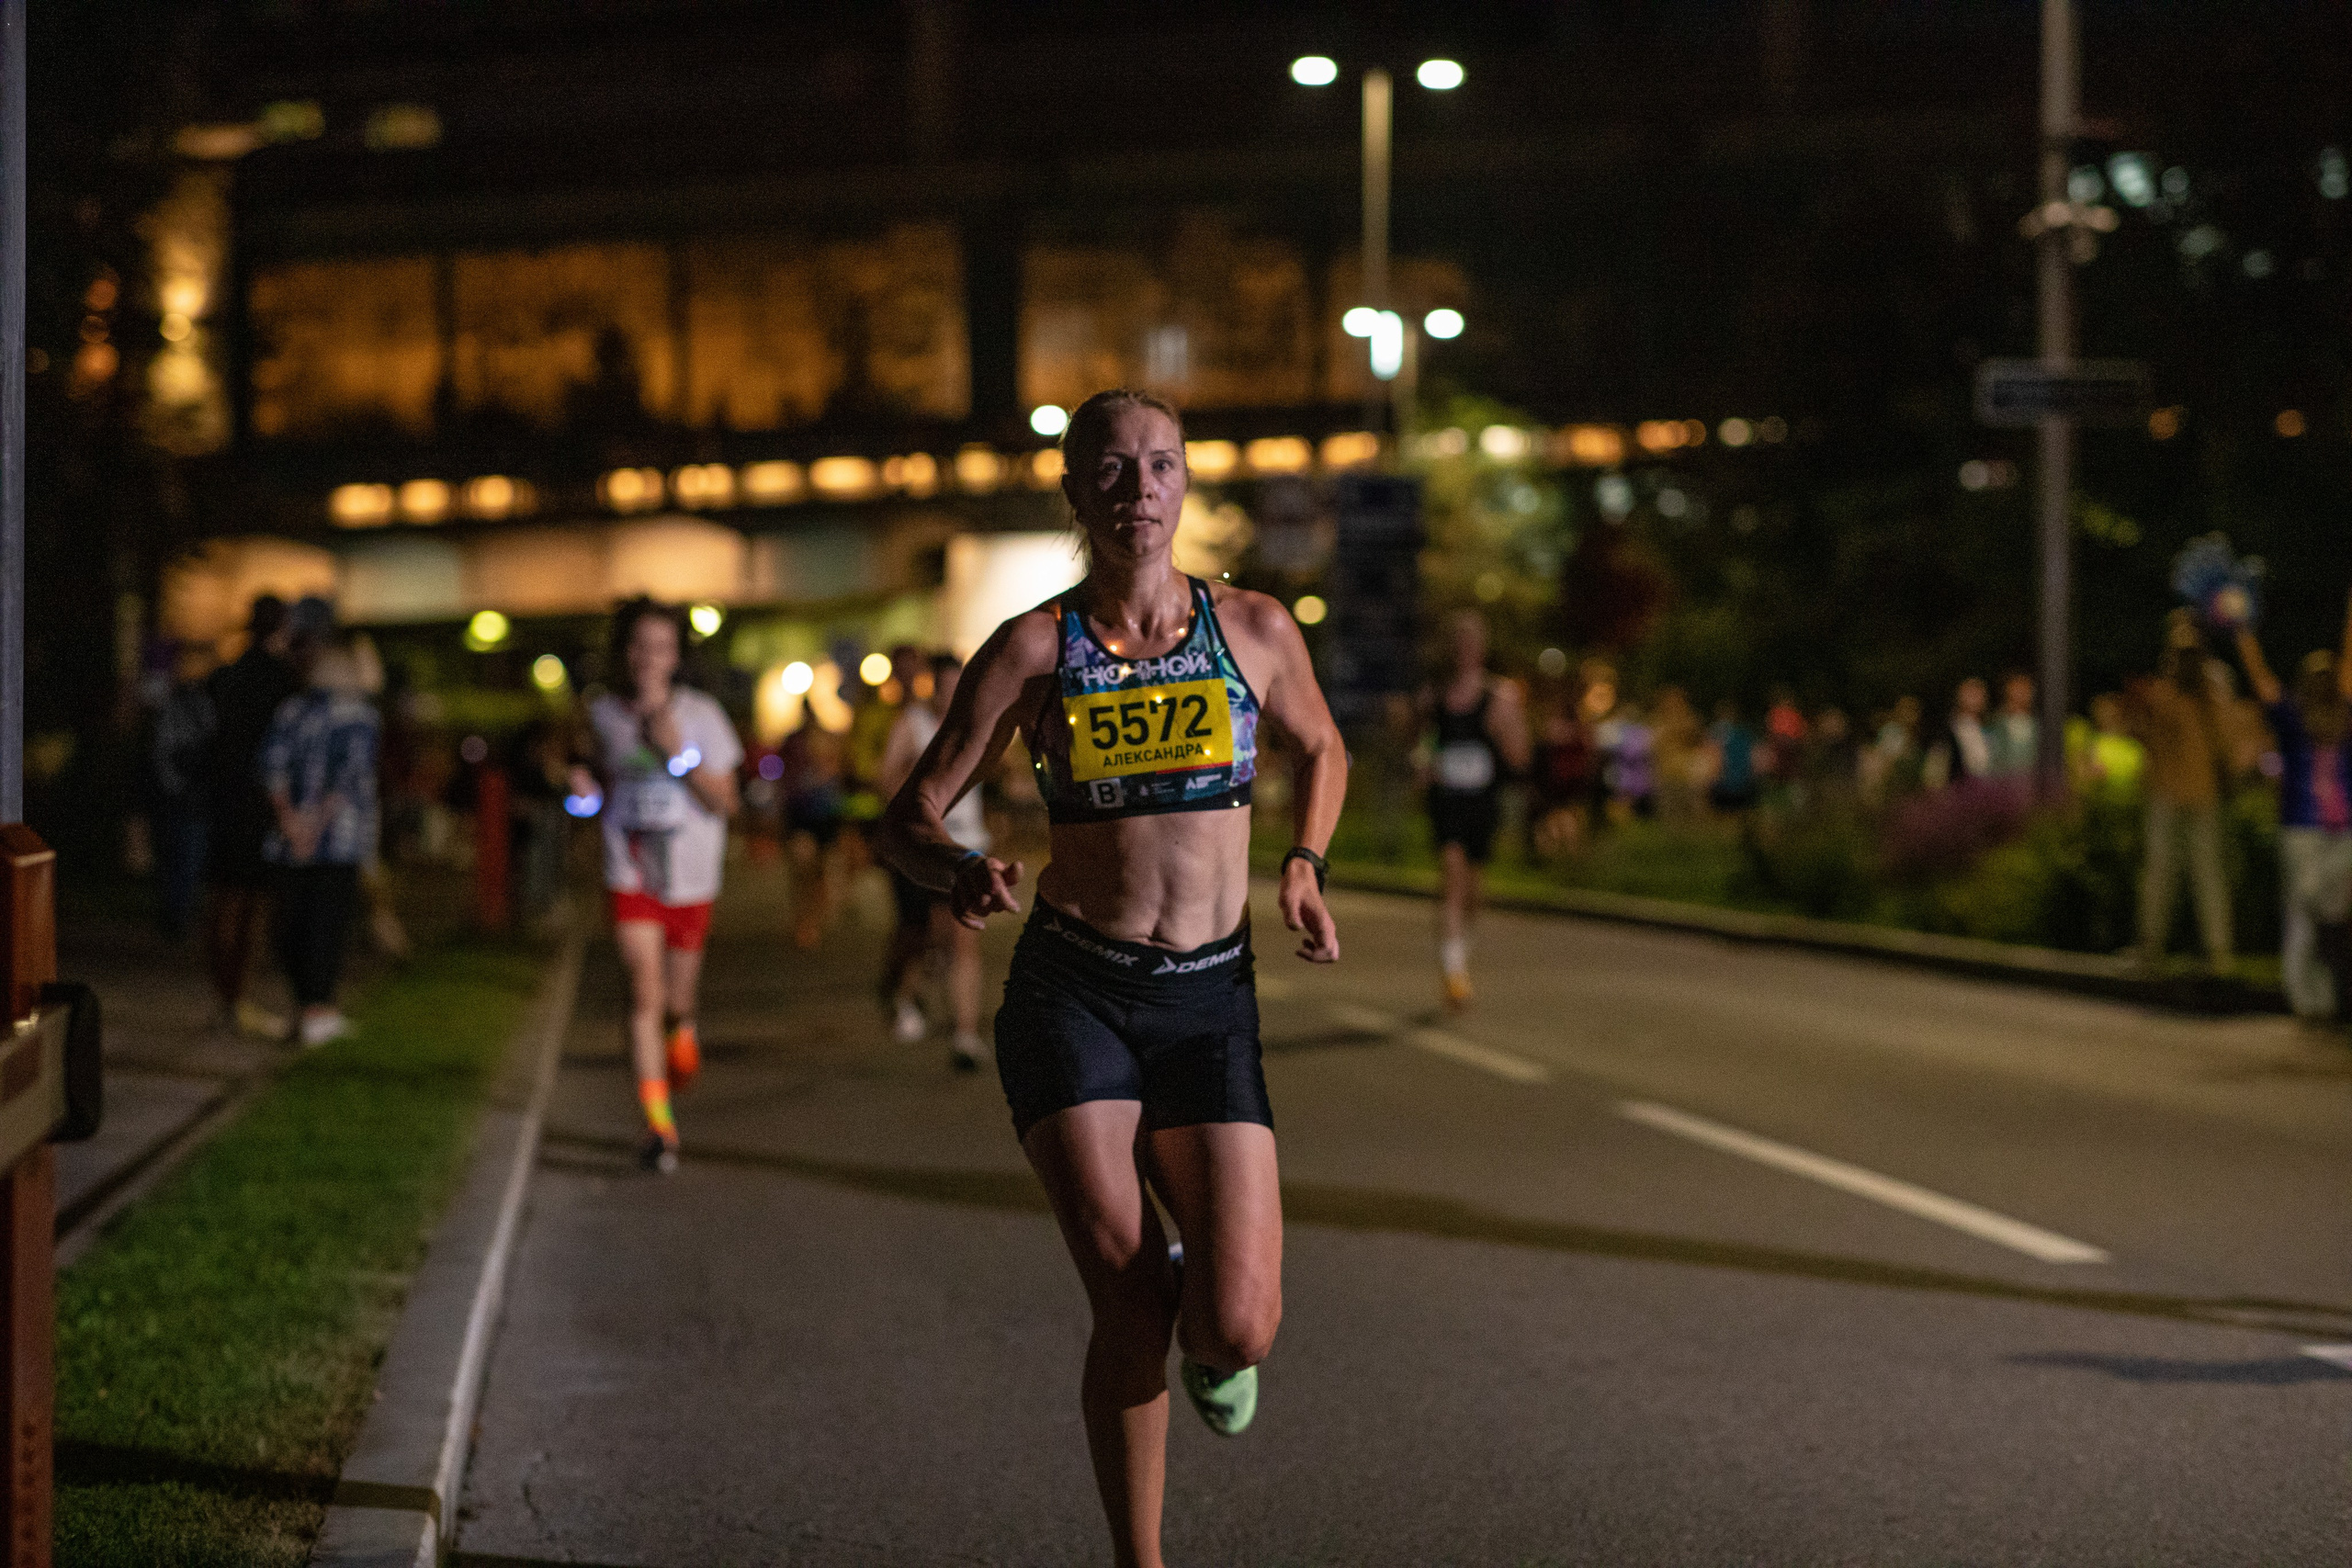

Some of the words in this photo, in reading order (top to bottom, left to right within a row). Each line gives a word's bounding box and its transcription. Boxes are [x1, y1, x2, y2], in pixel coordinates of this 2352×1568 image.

[1088, 694, 1213, 751] 5572
[1102, 742, 1204, 768] АЛЕКСАНДРА
[1061, 930, 1140, 967] DEMIX
[1174, 942, 1244, 975] DEMIX
